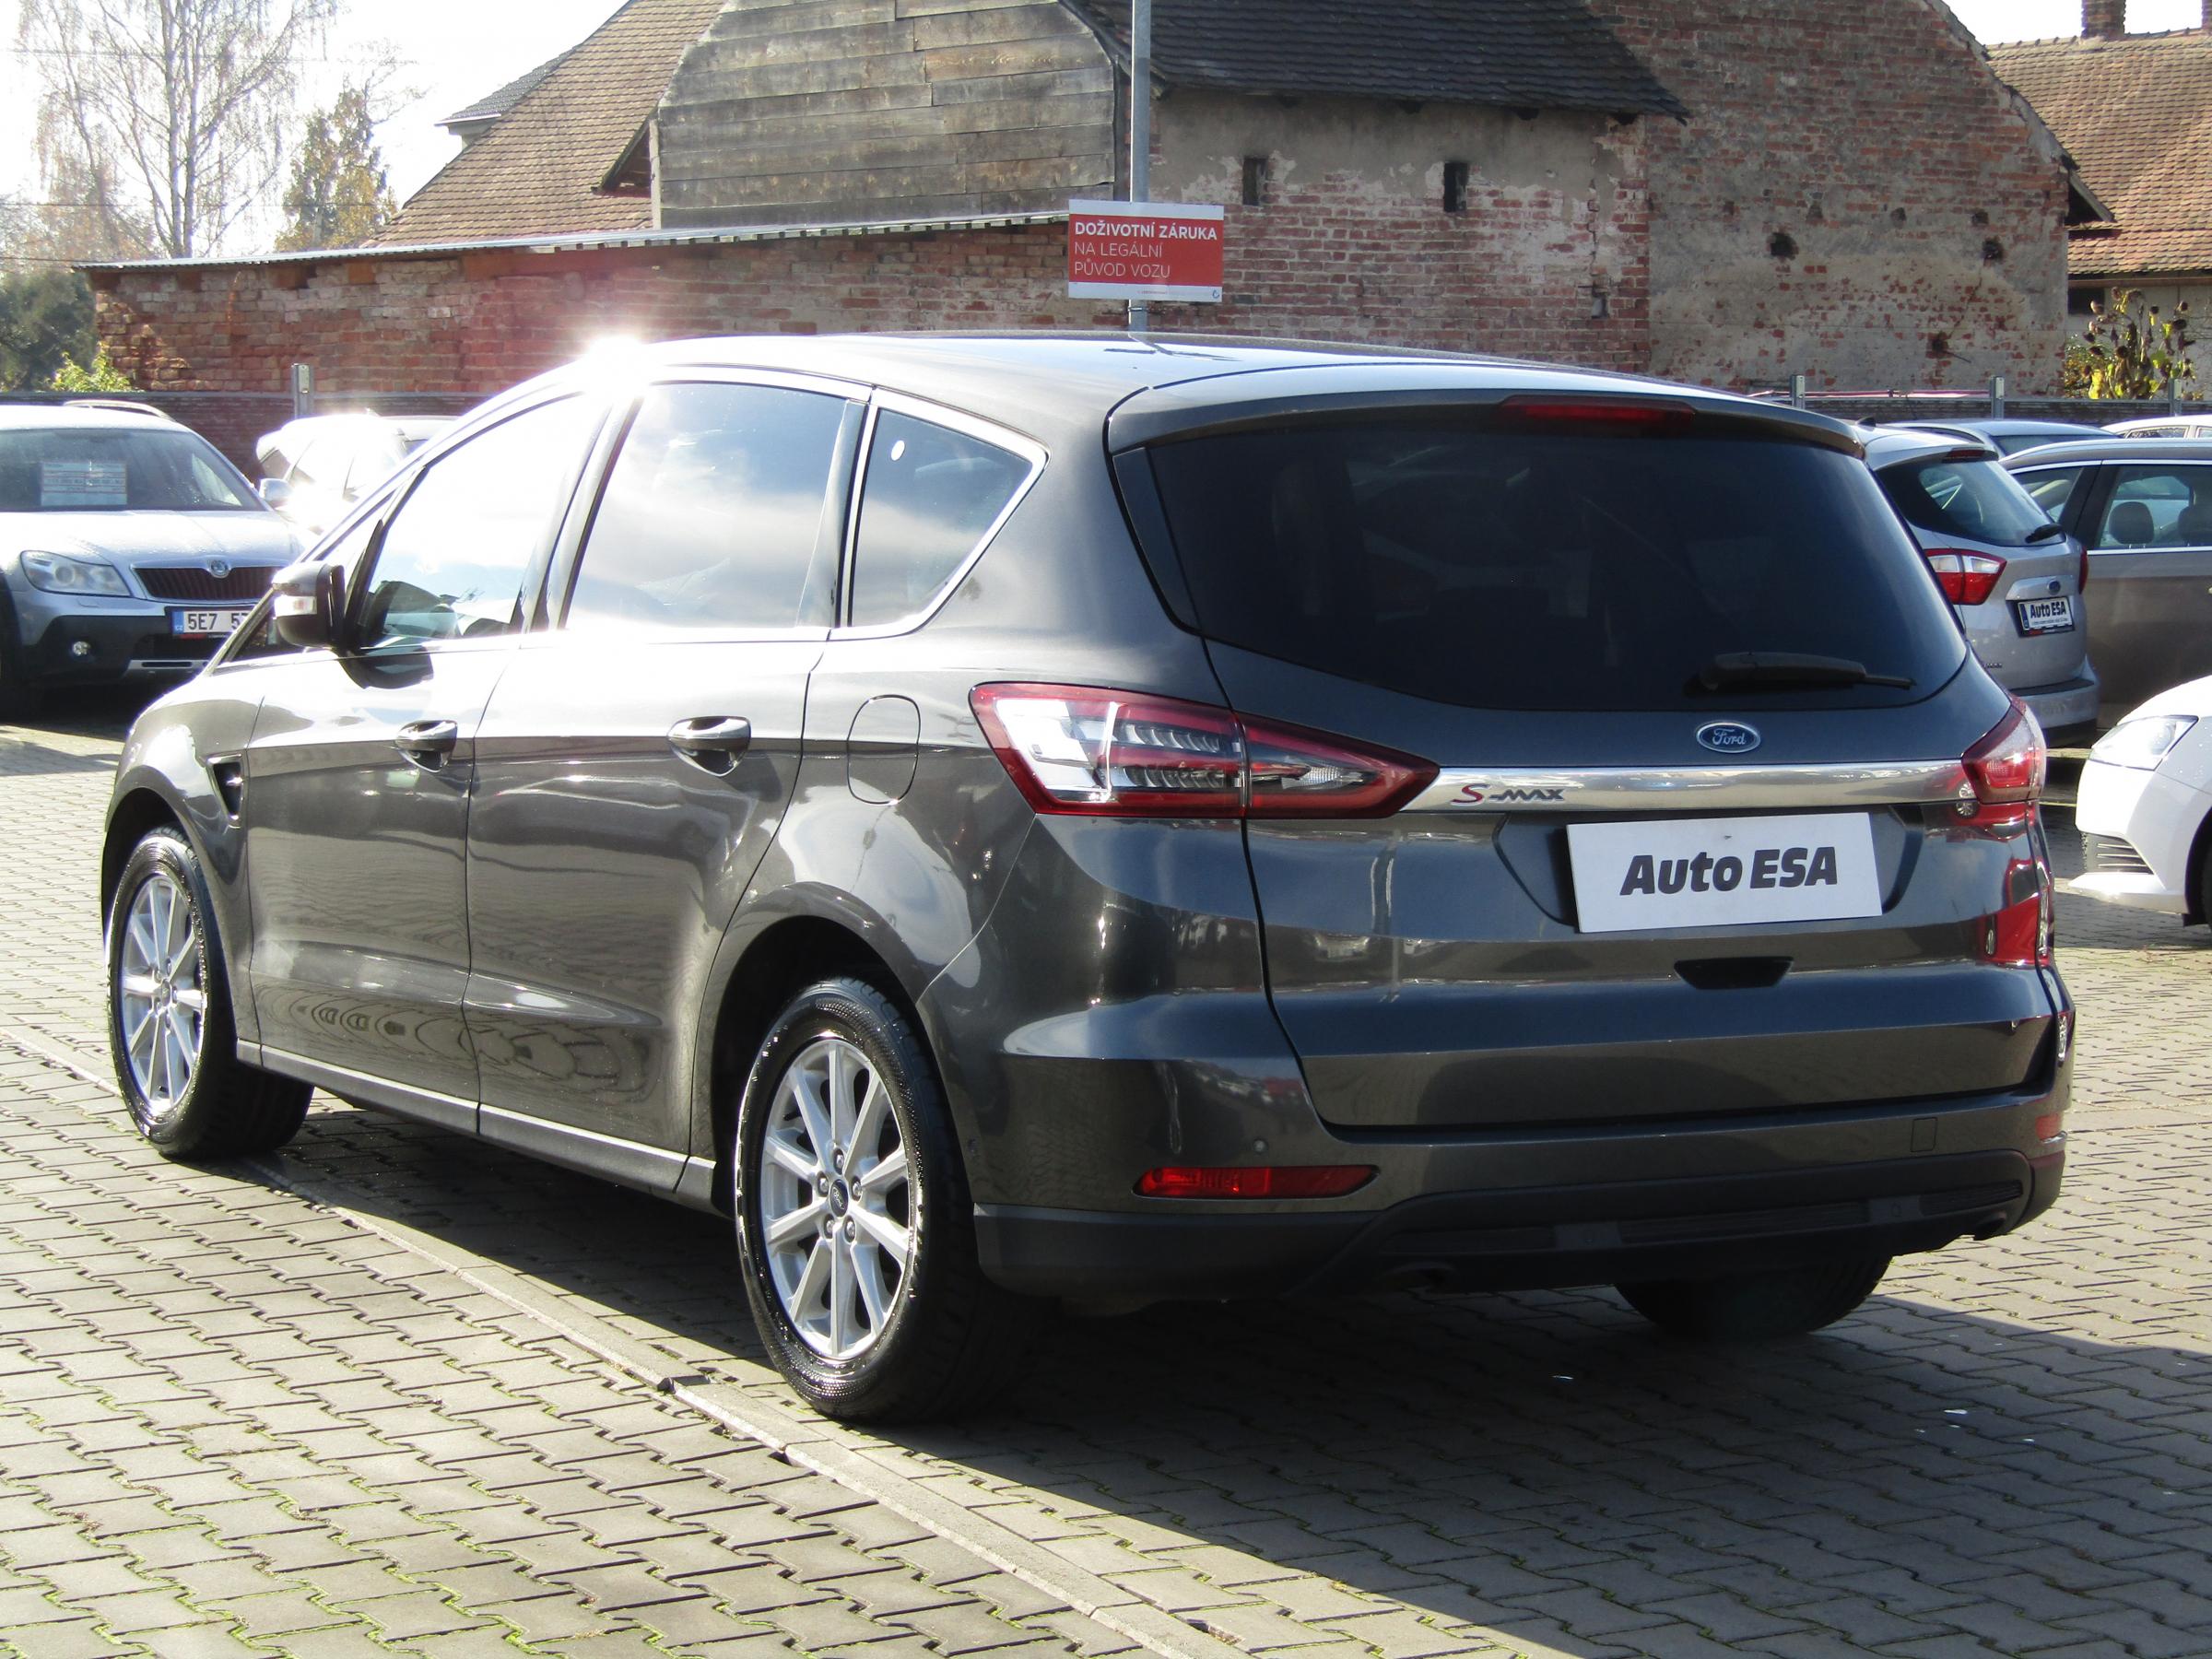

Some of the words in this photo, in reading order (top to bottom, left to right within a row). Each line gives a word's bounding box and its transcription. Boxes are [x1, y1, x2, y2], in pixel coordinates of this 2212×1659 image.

[1076, 219, 1155, 238] DOŽIVOTNÍ
[1159, 222, 1217, 241] ZÁRUKA
[1075, 241, 1095, 255] NA
[1100, 241, 1162, 257] LEGÁLNÍ
[1075, 258, 1125, 276] PŮVOD
[1131, 264, 1171, 277] VOZU
[2030, 603, 2051, 618] Auto
[2052, 601, 2067, 616] ESA
[188, 613, 218, 630] 5E7
[1712, 727, 1747, 745] Ford
[1450, 782, 1564, 804] S-MAX
[1619, 852, 1743, 896] Auto
[1750, 847, 1838, 888] ESA
